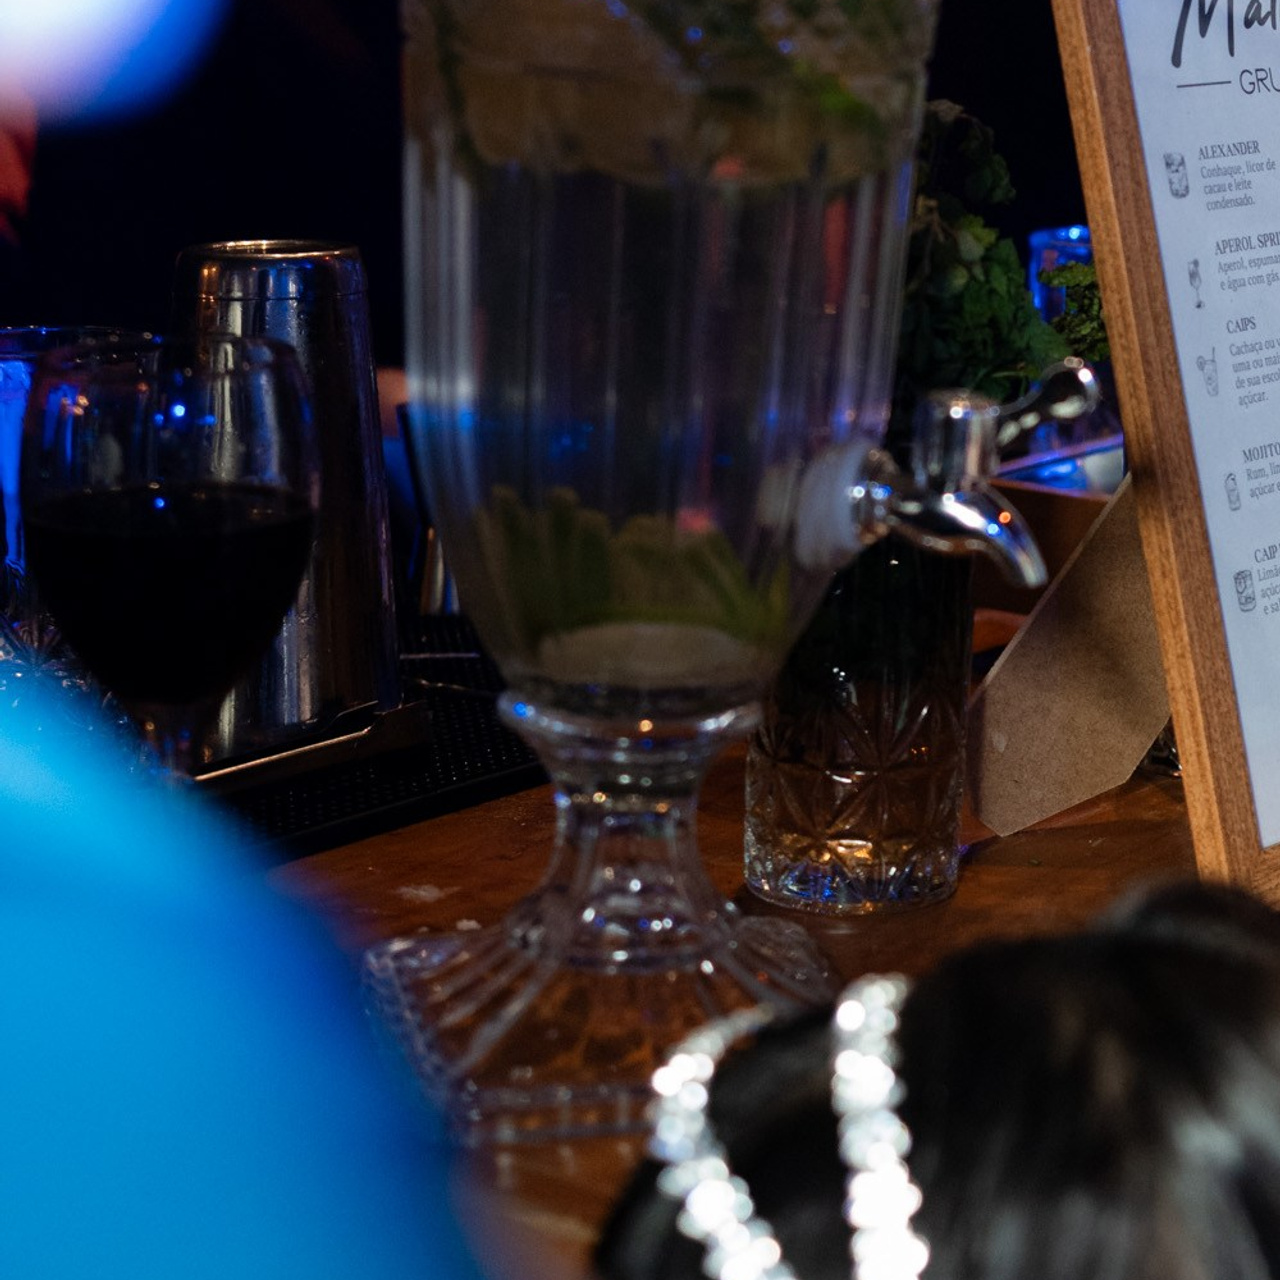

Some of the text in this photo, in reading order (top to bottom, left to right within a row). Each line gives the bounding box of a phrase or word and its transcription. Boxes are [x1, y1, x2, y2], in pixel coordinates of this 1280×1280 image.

[1198, 140, 1261, 160] ALEXANDER
[1200, 158, 1276, 179] Conhaque, licor de
[1203, 178, 1252, 195] cacau e leite
[1206, 193, 1255, 211] condensado.
[1214, 235, 1256, 256] APEROL
[1217, 257, 1247, 276] Aperol,
[1220, 280, 1226, 291] e
[1247, 273, 1266, 287] com
[1226, 316, 1257, 334] CAIPS
[1264, 338, 1275, 350] ou
[1232, 360, 1251, 373] uma
[1252, 358, 1264, 370] ou
[1235, 376, 1246, 389] de
[1247, 375, 1261, 387] sua
[1246, 467, 1269, 481] Rum,
[1254, 545, 1278, 564] CAIP
[1263, 605, 1269, 616] e
